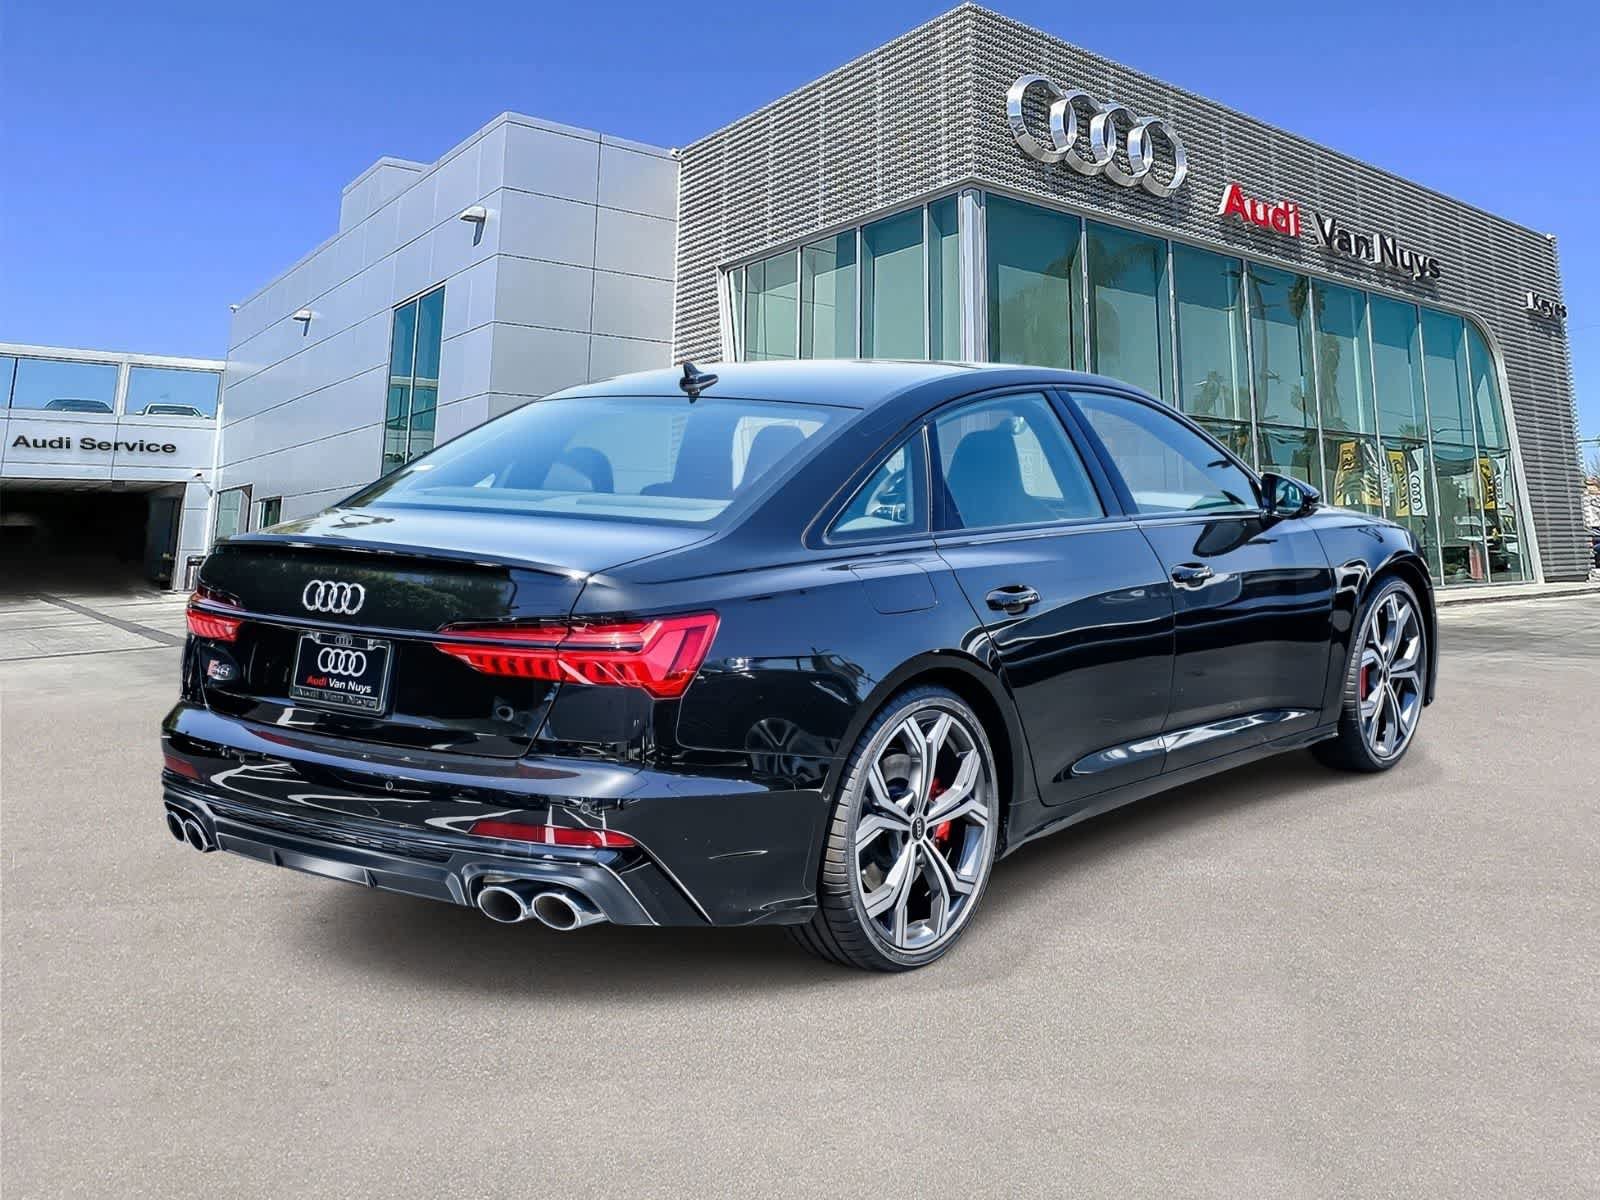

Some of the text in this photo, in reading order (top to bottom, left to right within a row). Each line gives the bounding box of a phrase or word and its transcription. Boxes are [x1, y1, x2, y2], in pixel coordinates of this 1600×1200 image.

[1218, 183, 1441, 280] Audi Van Nuys
[12, 435, 177, 454] Audi Service
[306, 675, 372, 694] Audi Van Nuys
